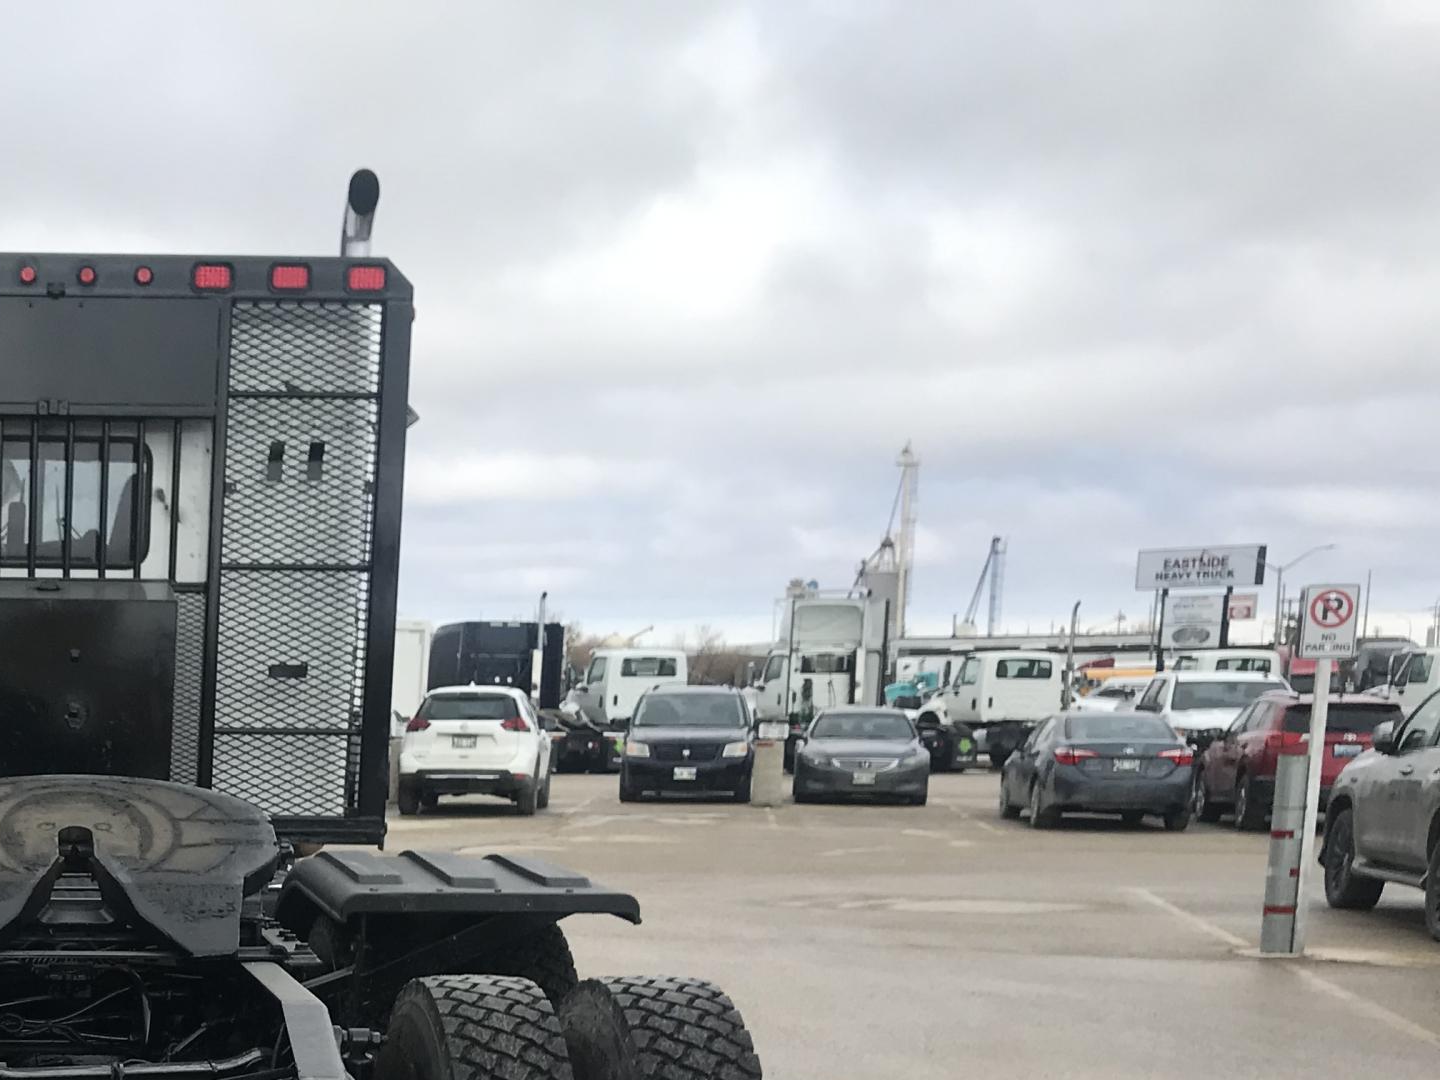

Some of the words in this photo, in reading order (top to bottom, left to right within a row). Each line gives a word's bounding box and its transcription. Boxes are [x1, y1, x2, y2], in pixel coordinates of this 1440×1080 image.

[1155, 571, 1191, 581] HEAVY
[1196, 570, 1235, 579] TRUCK
[1321, 633, 1336, 641] NO
[1305, 643, 1351, 651] PARING
